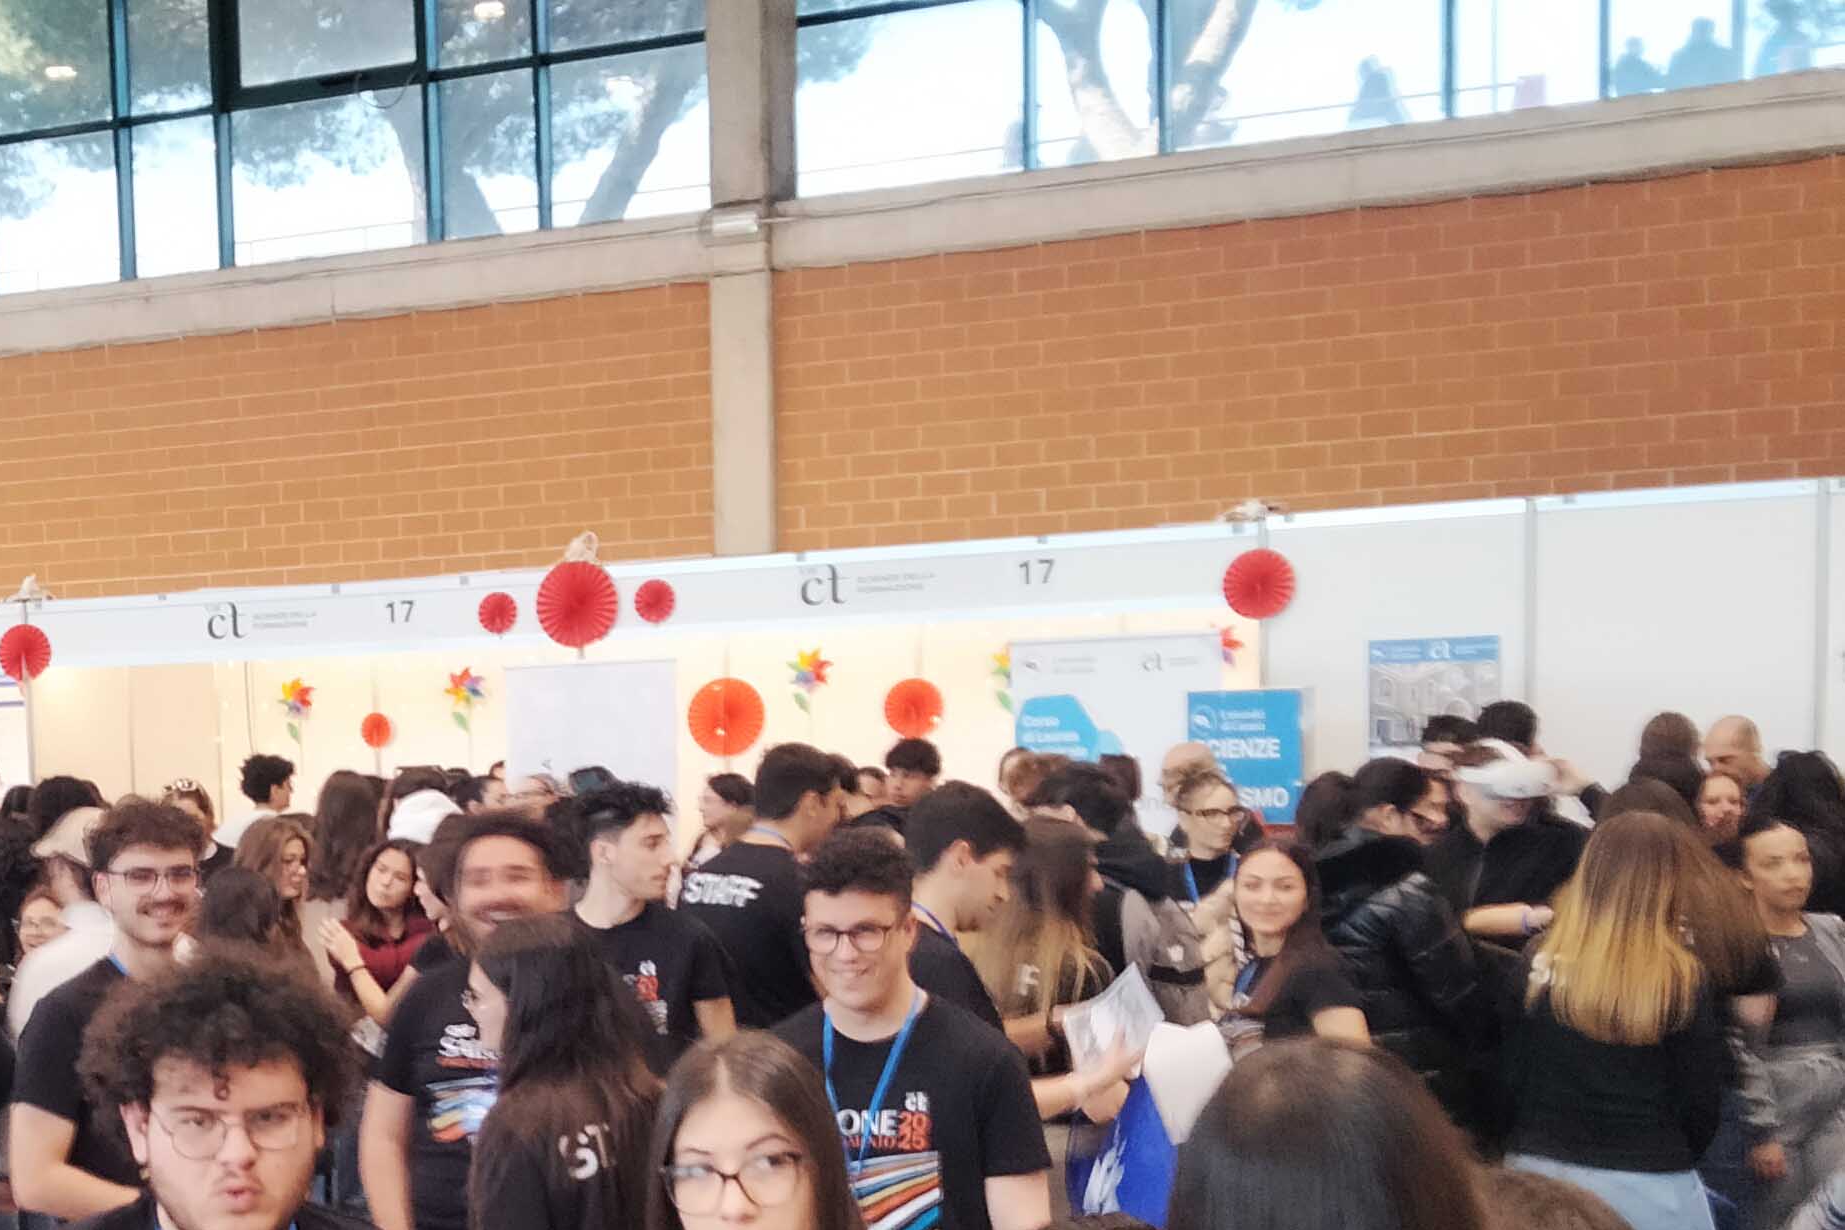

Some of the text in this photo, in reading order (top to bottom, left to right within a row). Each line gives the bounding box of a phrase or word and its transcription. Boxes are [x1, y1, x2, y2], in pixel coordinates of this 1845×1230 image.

[1018, 558, 1055, 585] 17
[385, 599, 414, 624] 17
[684, 872, 764, 908] STAFF
